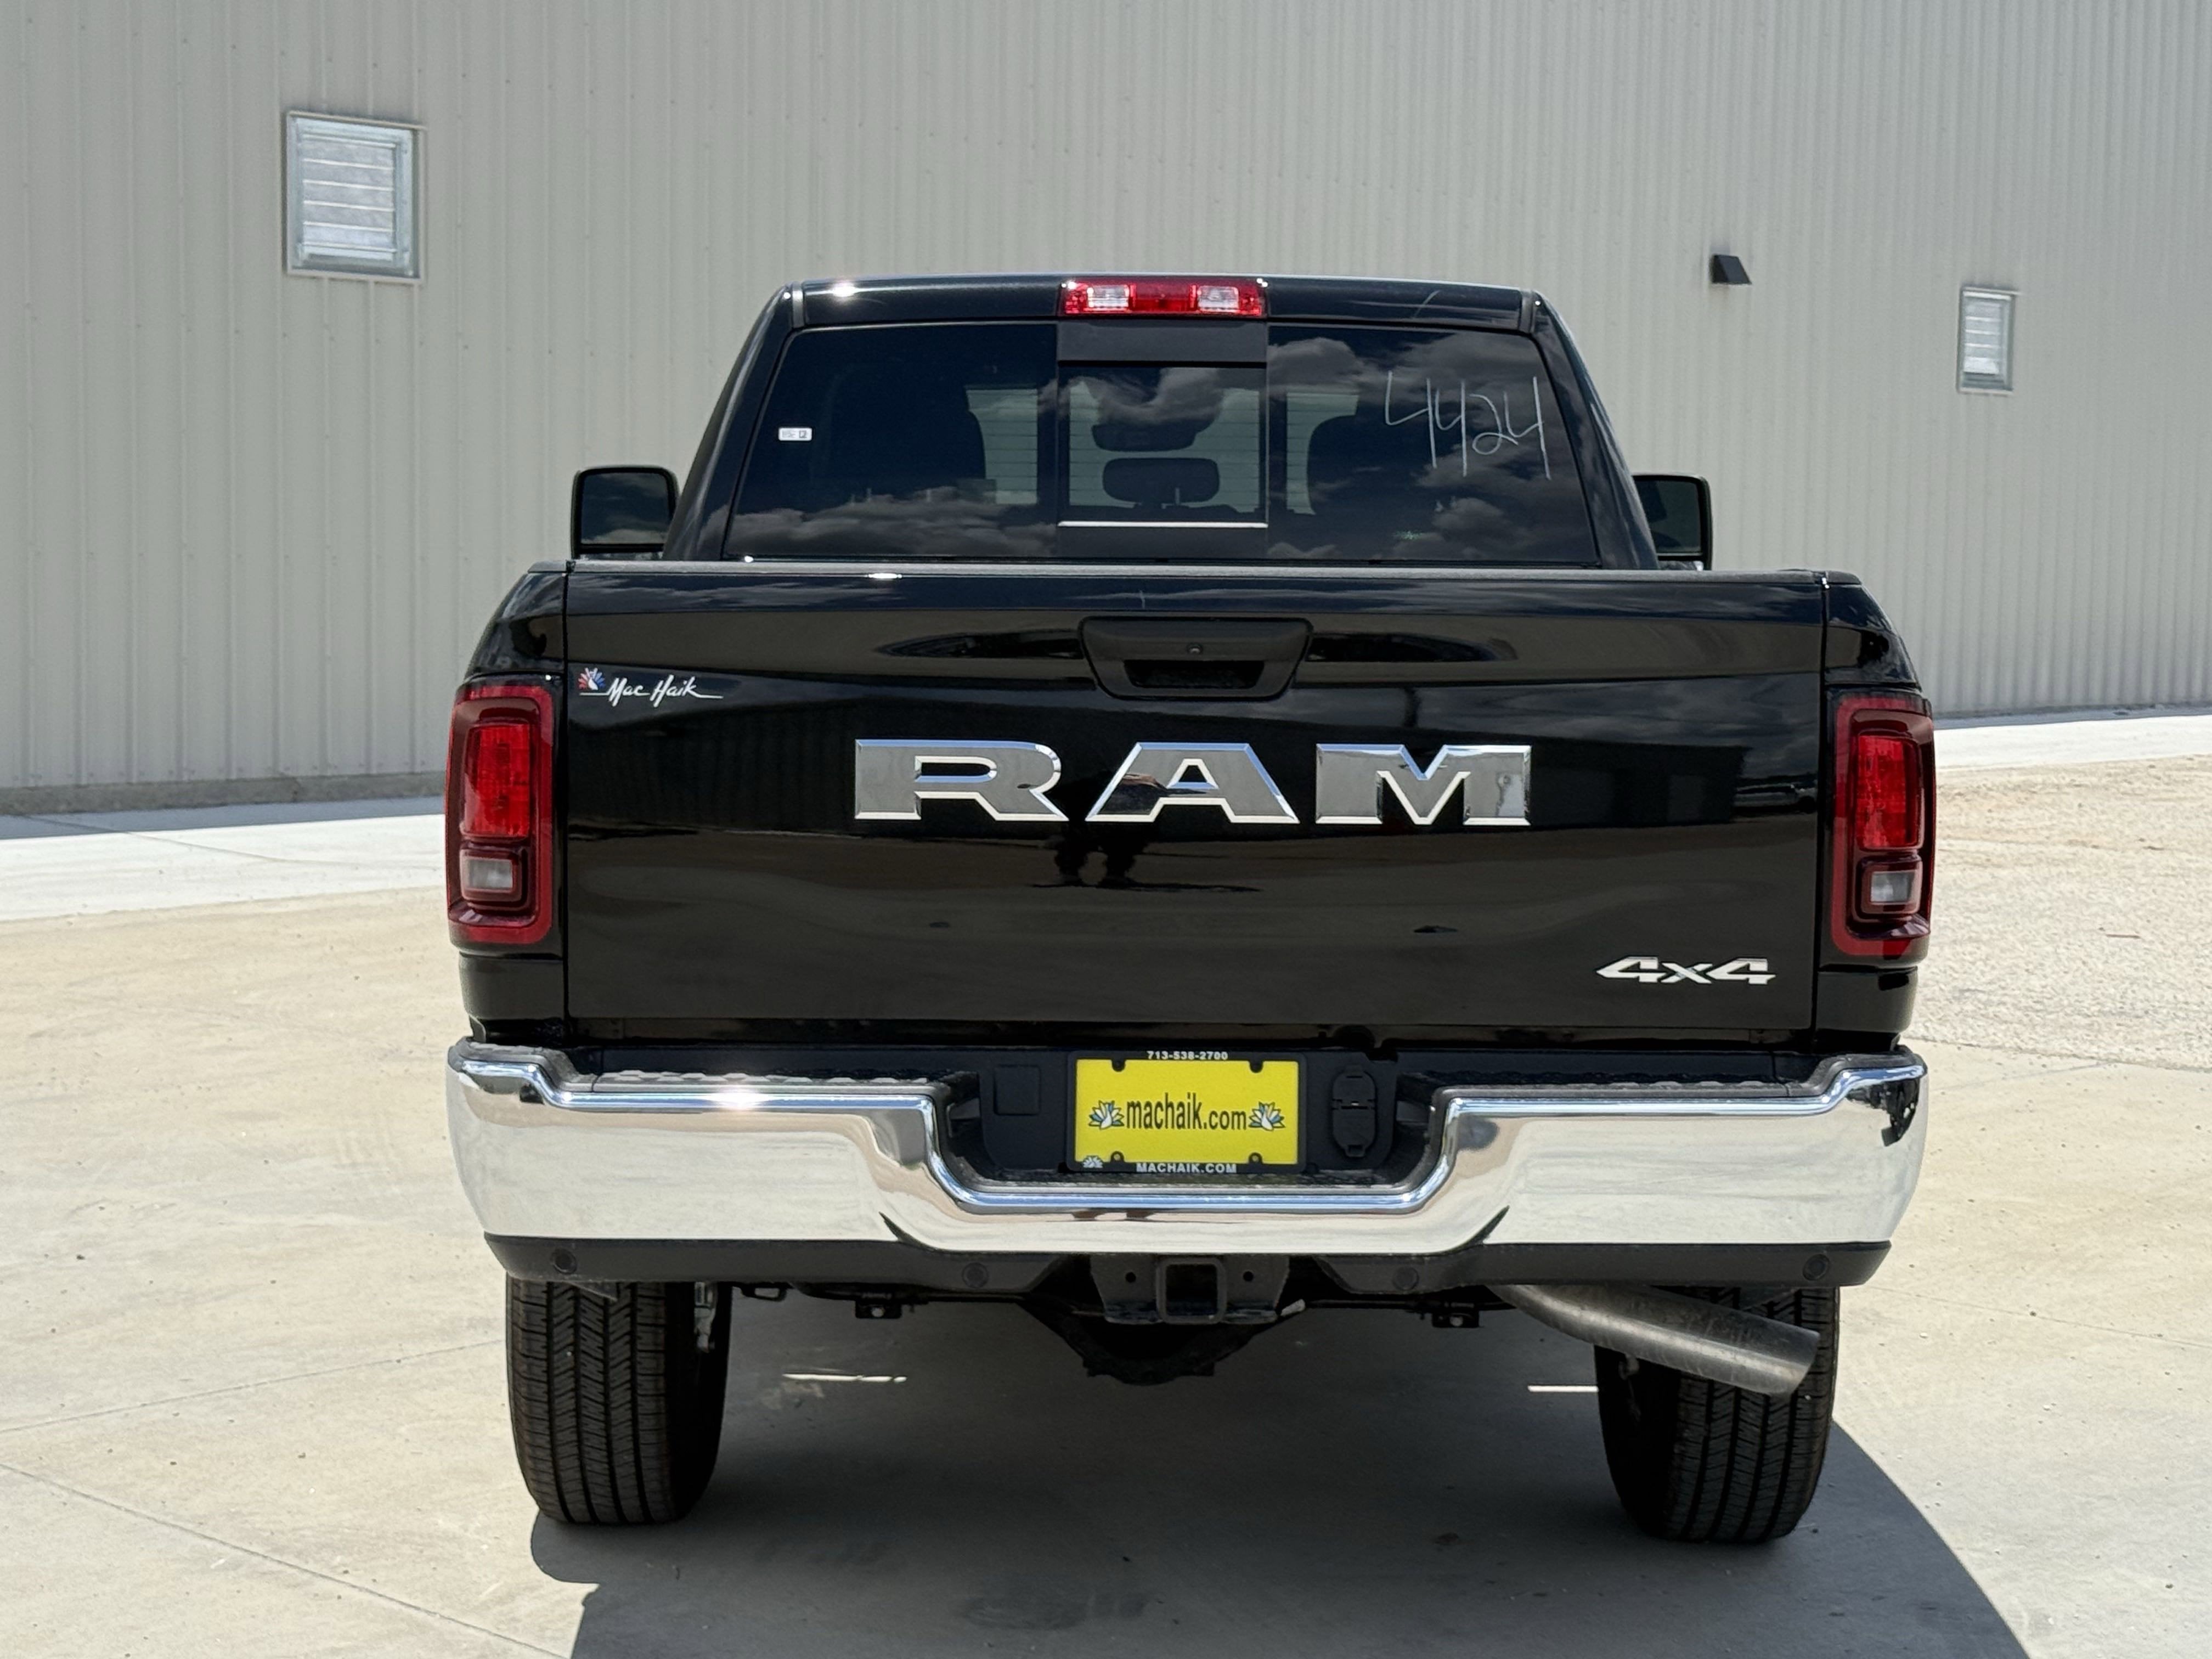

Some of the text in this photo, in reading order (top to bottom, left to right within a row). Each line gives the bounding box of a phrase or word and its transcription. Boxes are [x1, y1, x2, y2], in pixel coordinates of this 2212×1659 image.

[1384, 370, 1551, 480] 4424
[579, 674, 724, 708] Mac Haik
[855, 739, 1532, 825] RAM
[1595, 956, 1776, 985] 4x4
[1147, 1051, 1228, 1060] 713-538-2700
[1126, 1092, 1247, 1131] machaik.com
[1136, 1163, 1237, 1173] MACHAIK.COM
